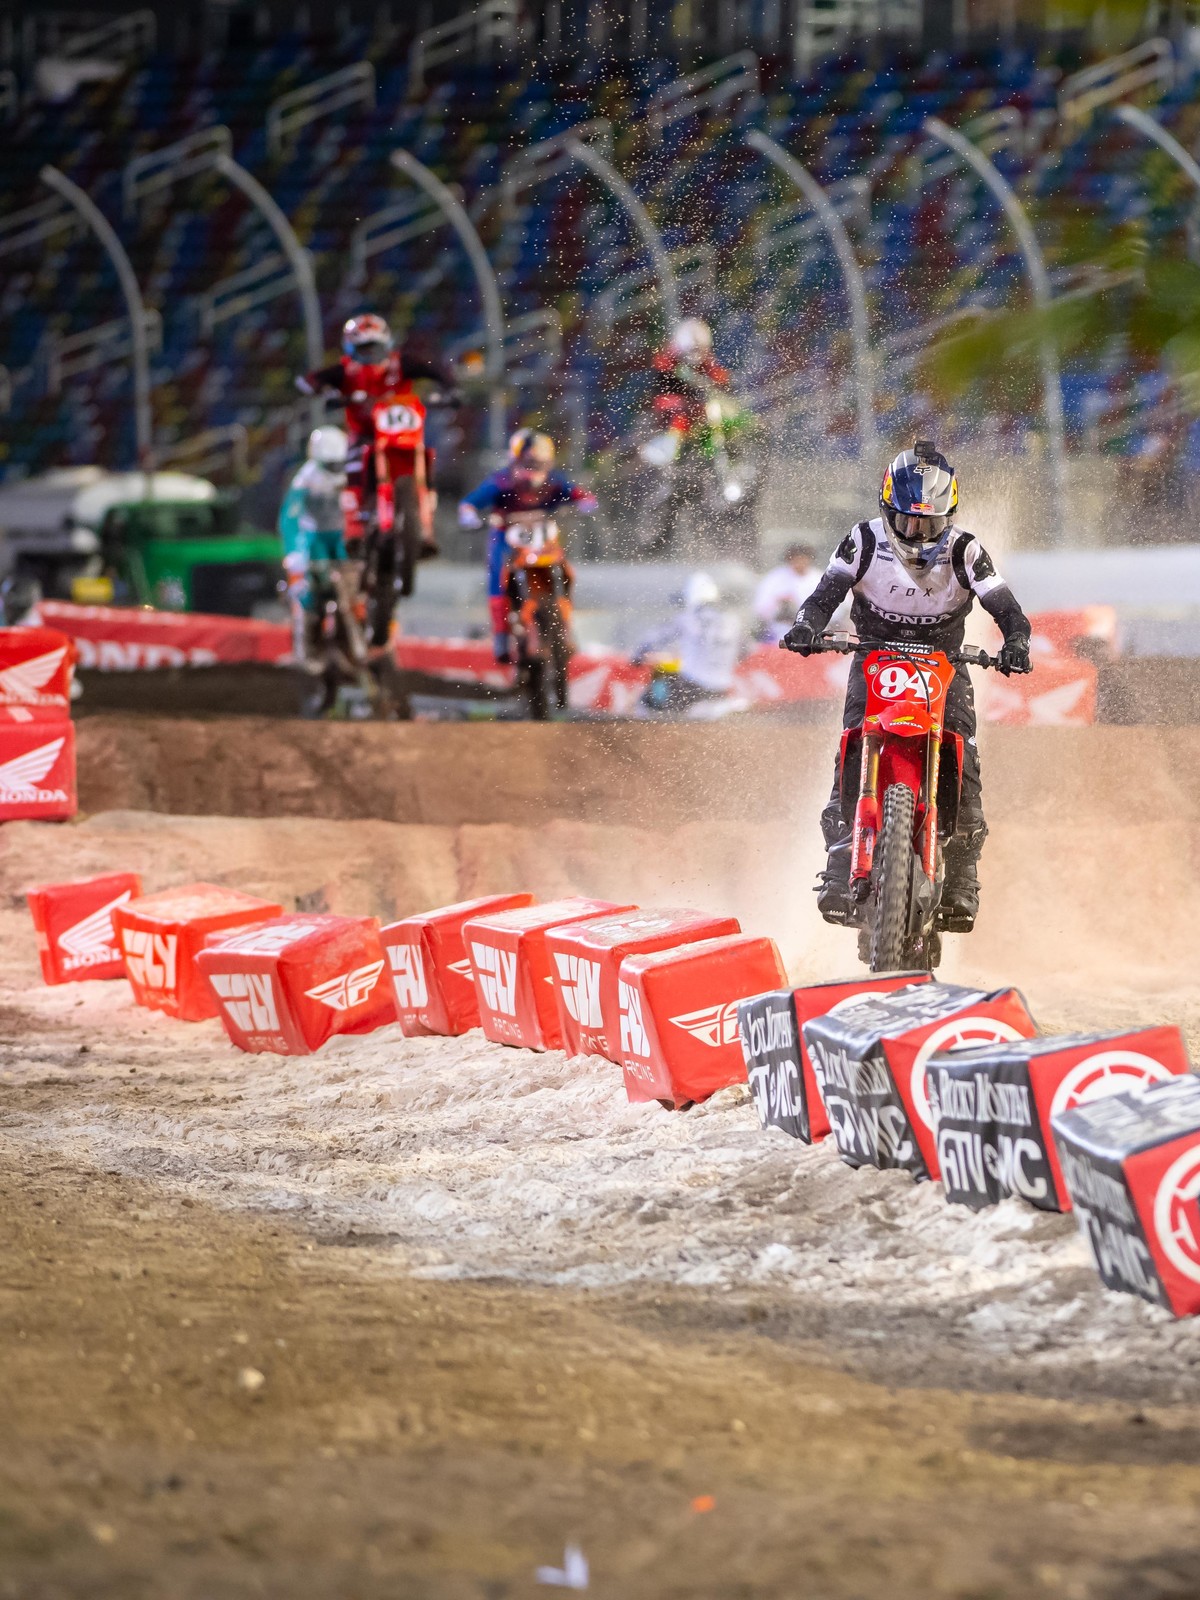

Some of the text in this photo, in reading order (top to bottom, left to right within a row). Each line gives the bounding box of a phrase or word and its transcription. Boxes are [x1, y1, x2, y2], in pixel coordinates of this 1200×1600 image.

[869, 602, 953, 625] HONDA
[889, 585, 933, 597] FOX
[879, 666, 934, 700] 94
[888, 721, 924, 730] HONDA
[121, 928, 178, 989] FLY
[470, 941, 518, 1018] FLY
[208, 973, 280, 1032] FLY
[552, 951, 604, 1029] FLY
[938, 1128, 987, 1194] ATV
